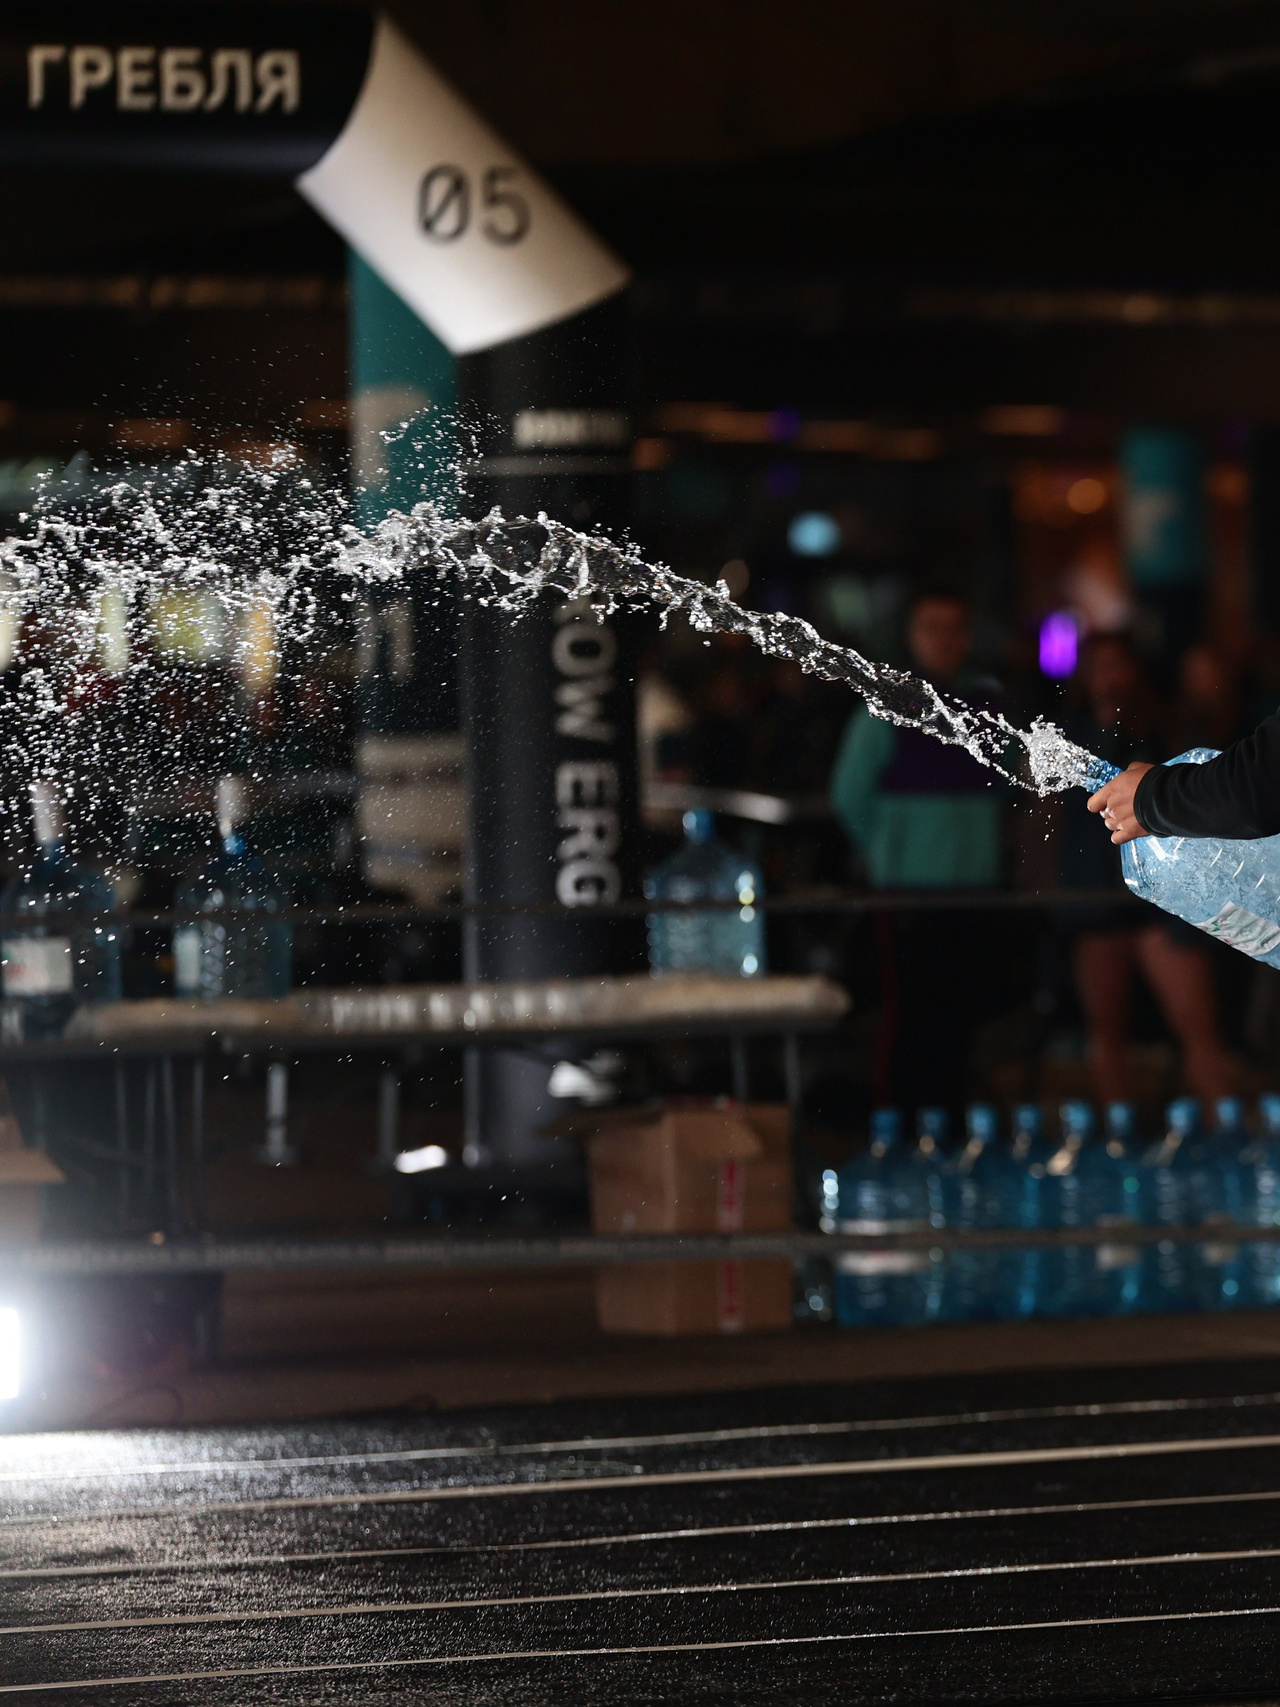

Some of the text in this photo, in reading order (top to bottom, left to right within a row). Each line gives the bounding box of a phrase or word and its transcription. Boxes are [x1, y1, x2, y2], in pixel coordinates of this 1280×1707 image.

[26, 44, 302, 115] ГРЕБЛЯ
[418, 163, 533, 245] 05
[554, 760, 622, 907] ERG
